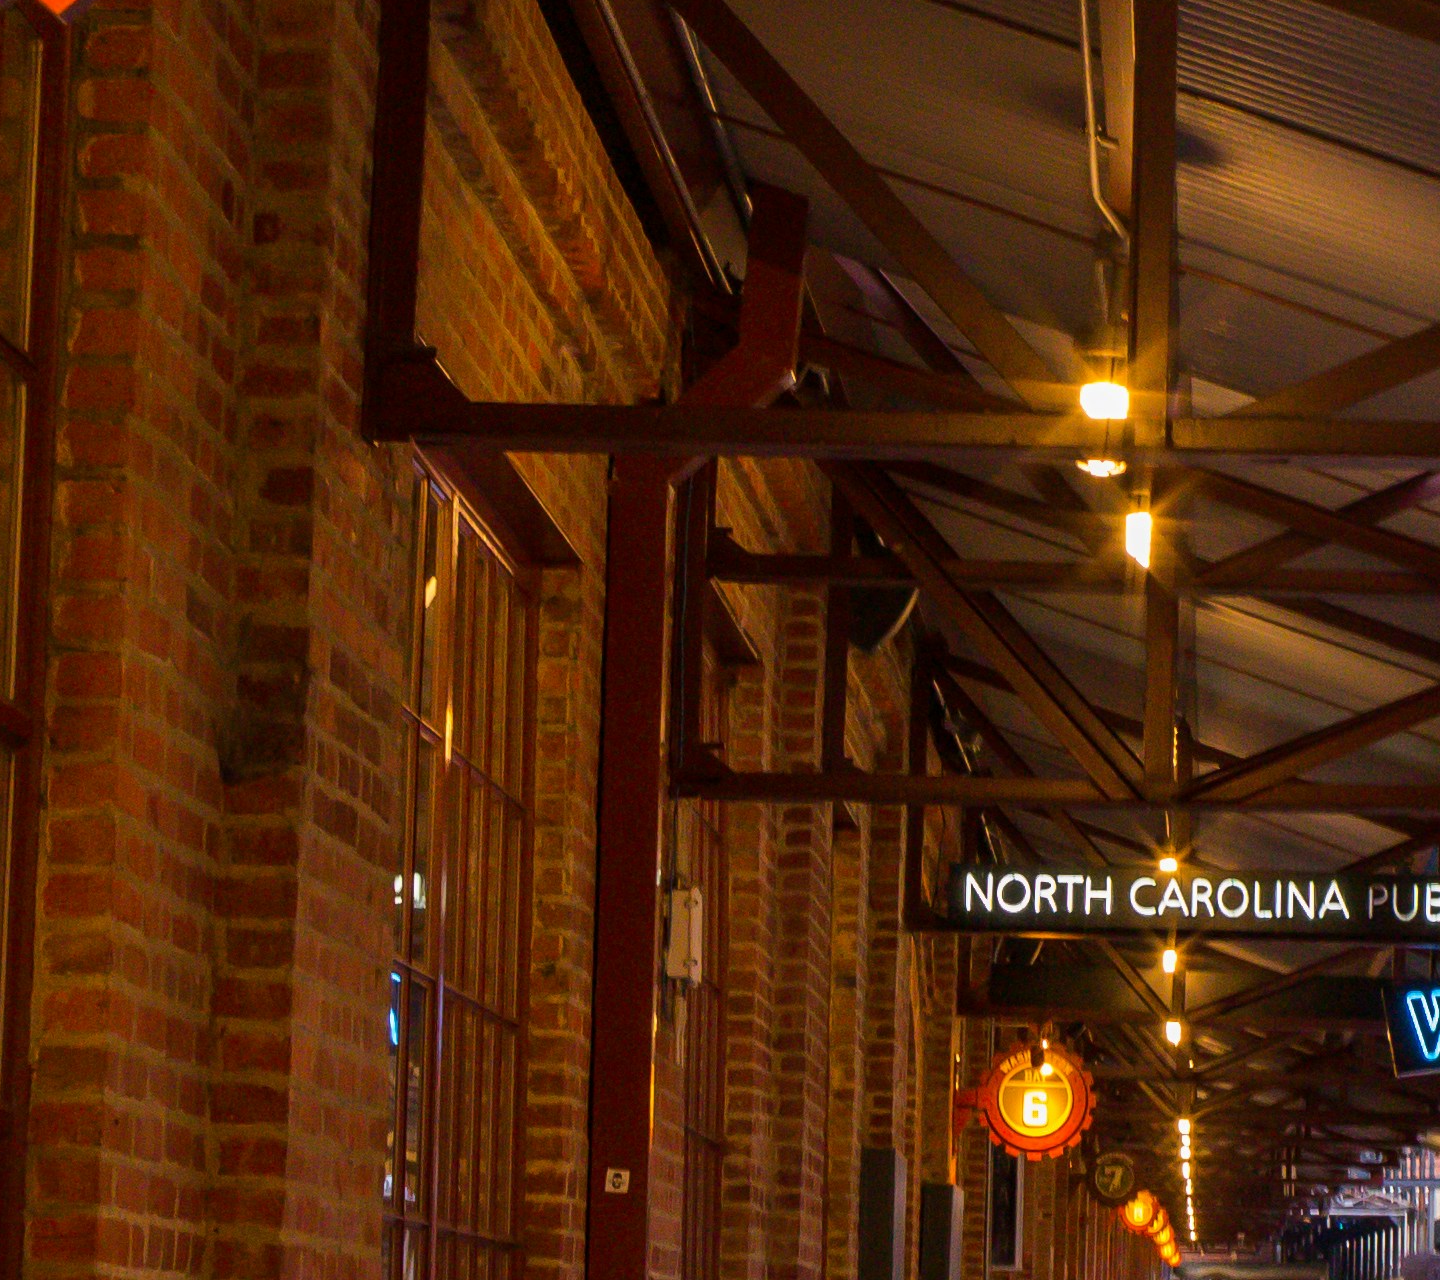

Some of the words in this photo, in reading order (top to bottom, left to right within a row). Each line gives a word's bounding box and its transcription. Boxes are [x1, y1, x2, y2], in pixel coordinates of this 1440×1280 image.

[964, 872, 1113, 916] NORTH
[1128, 876, 1351, 920] CAROLINA
[1022, 1090, 1049, 1127] 6
